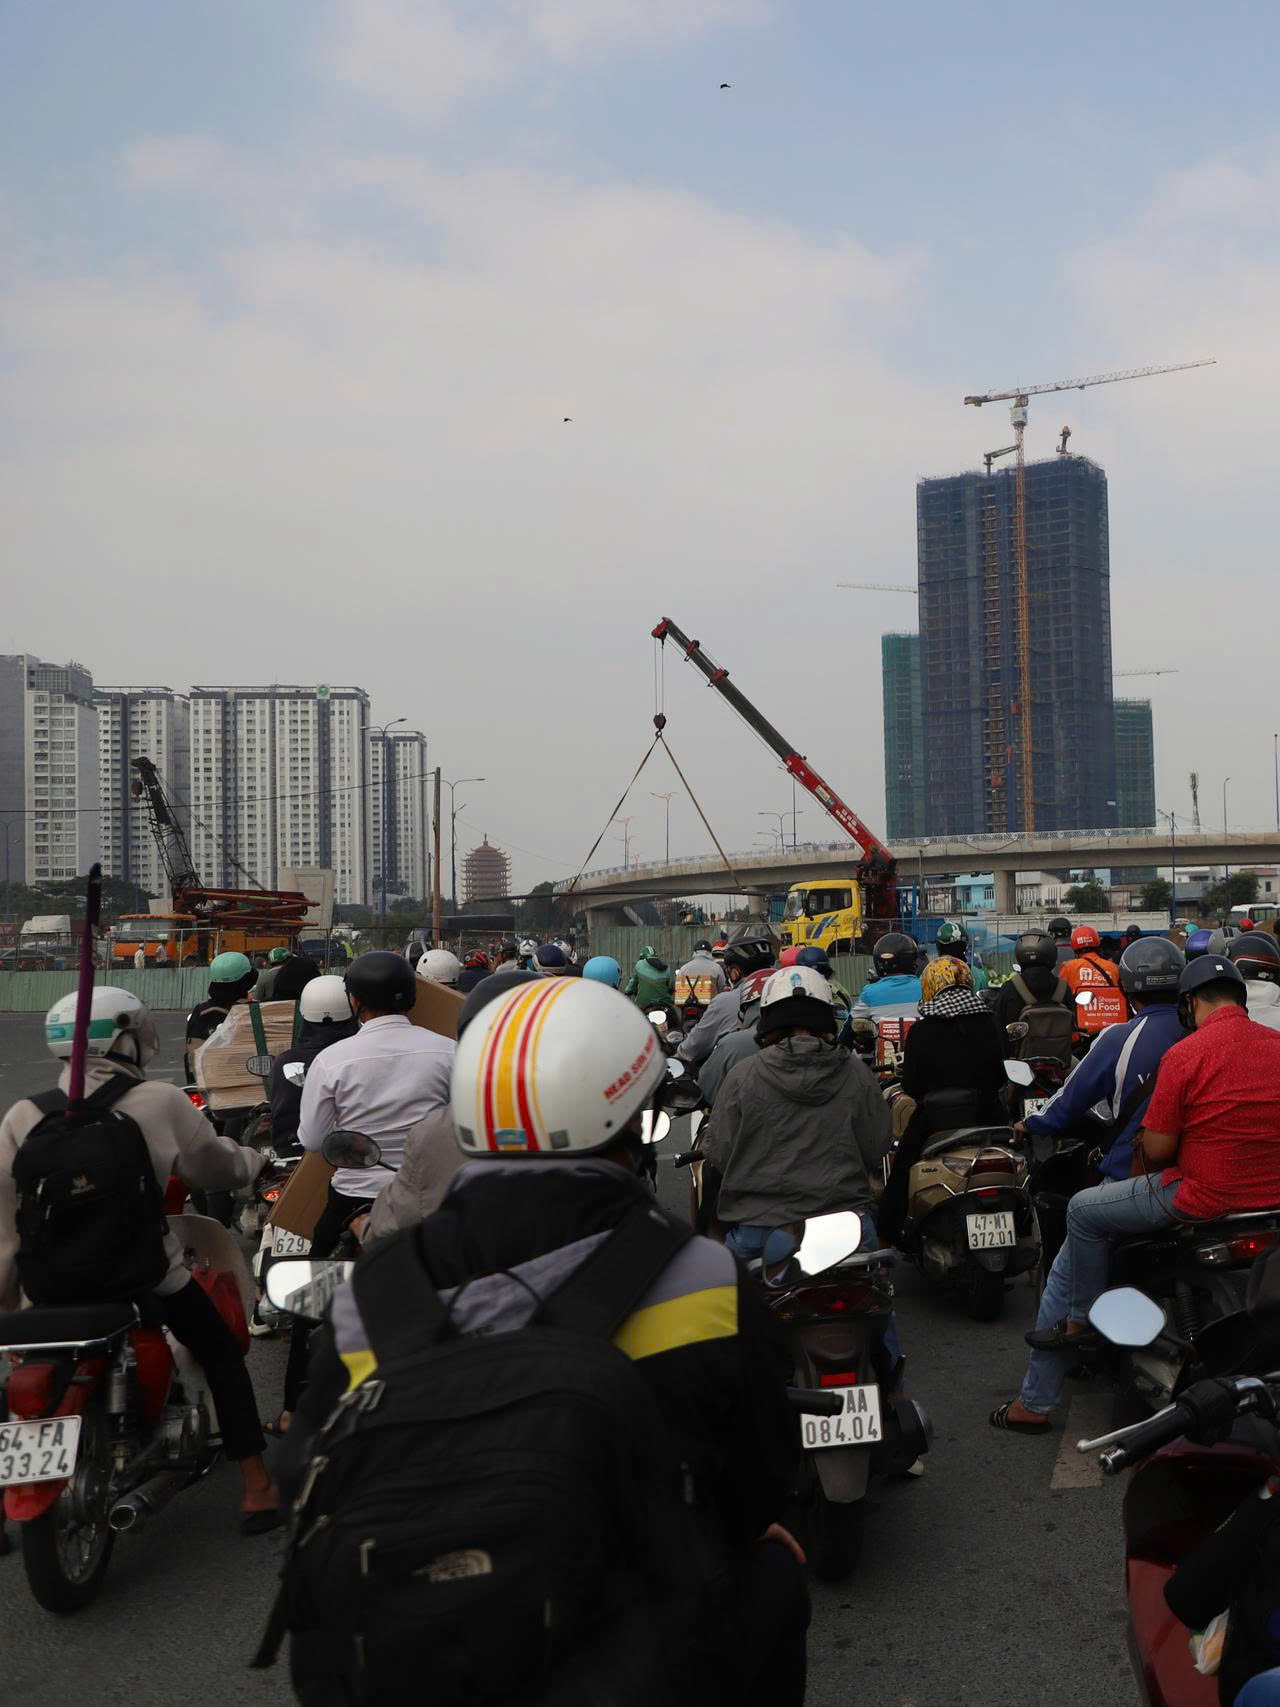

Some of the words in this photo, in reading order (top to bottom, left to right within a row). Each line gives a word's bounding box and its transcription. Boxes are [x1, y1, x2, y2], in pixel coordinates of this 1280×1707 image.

[1098, 1002, 1121, 1011] Food
[970, 1230, 1014, 1248] 372.01
[846, 1388, 868, 1414] AA
[0, 1421, 65, 1453] 64-FA
[805, 1415, 879, 1446] 084.04
[0, 1448, 69, 1480] 33.24
